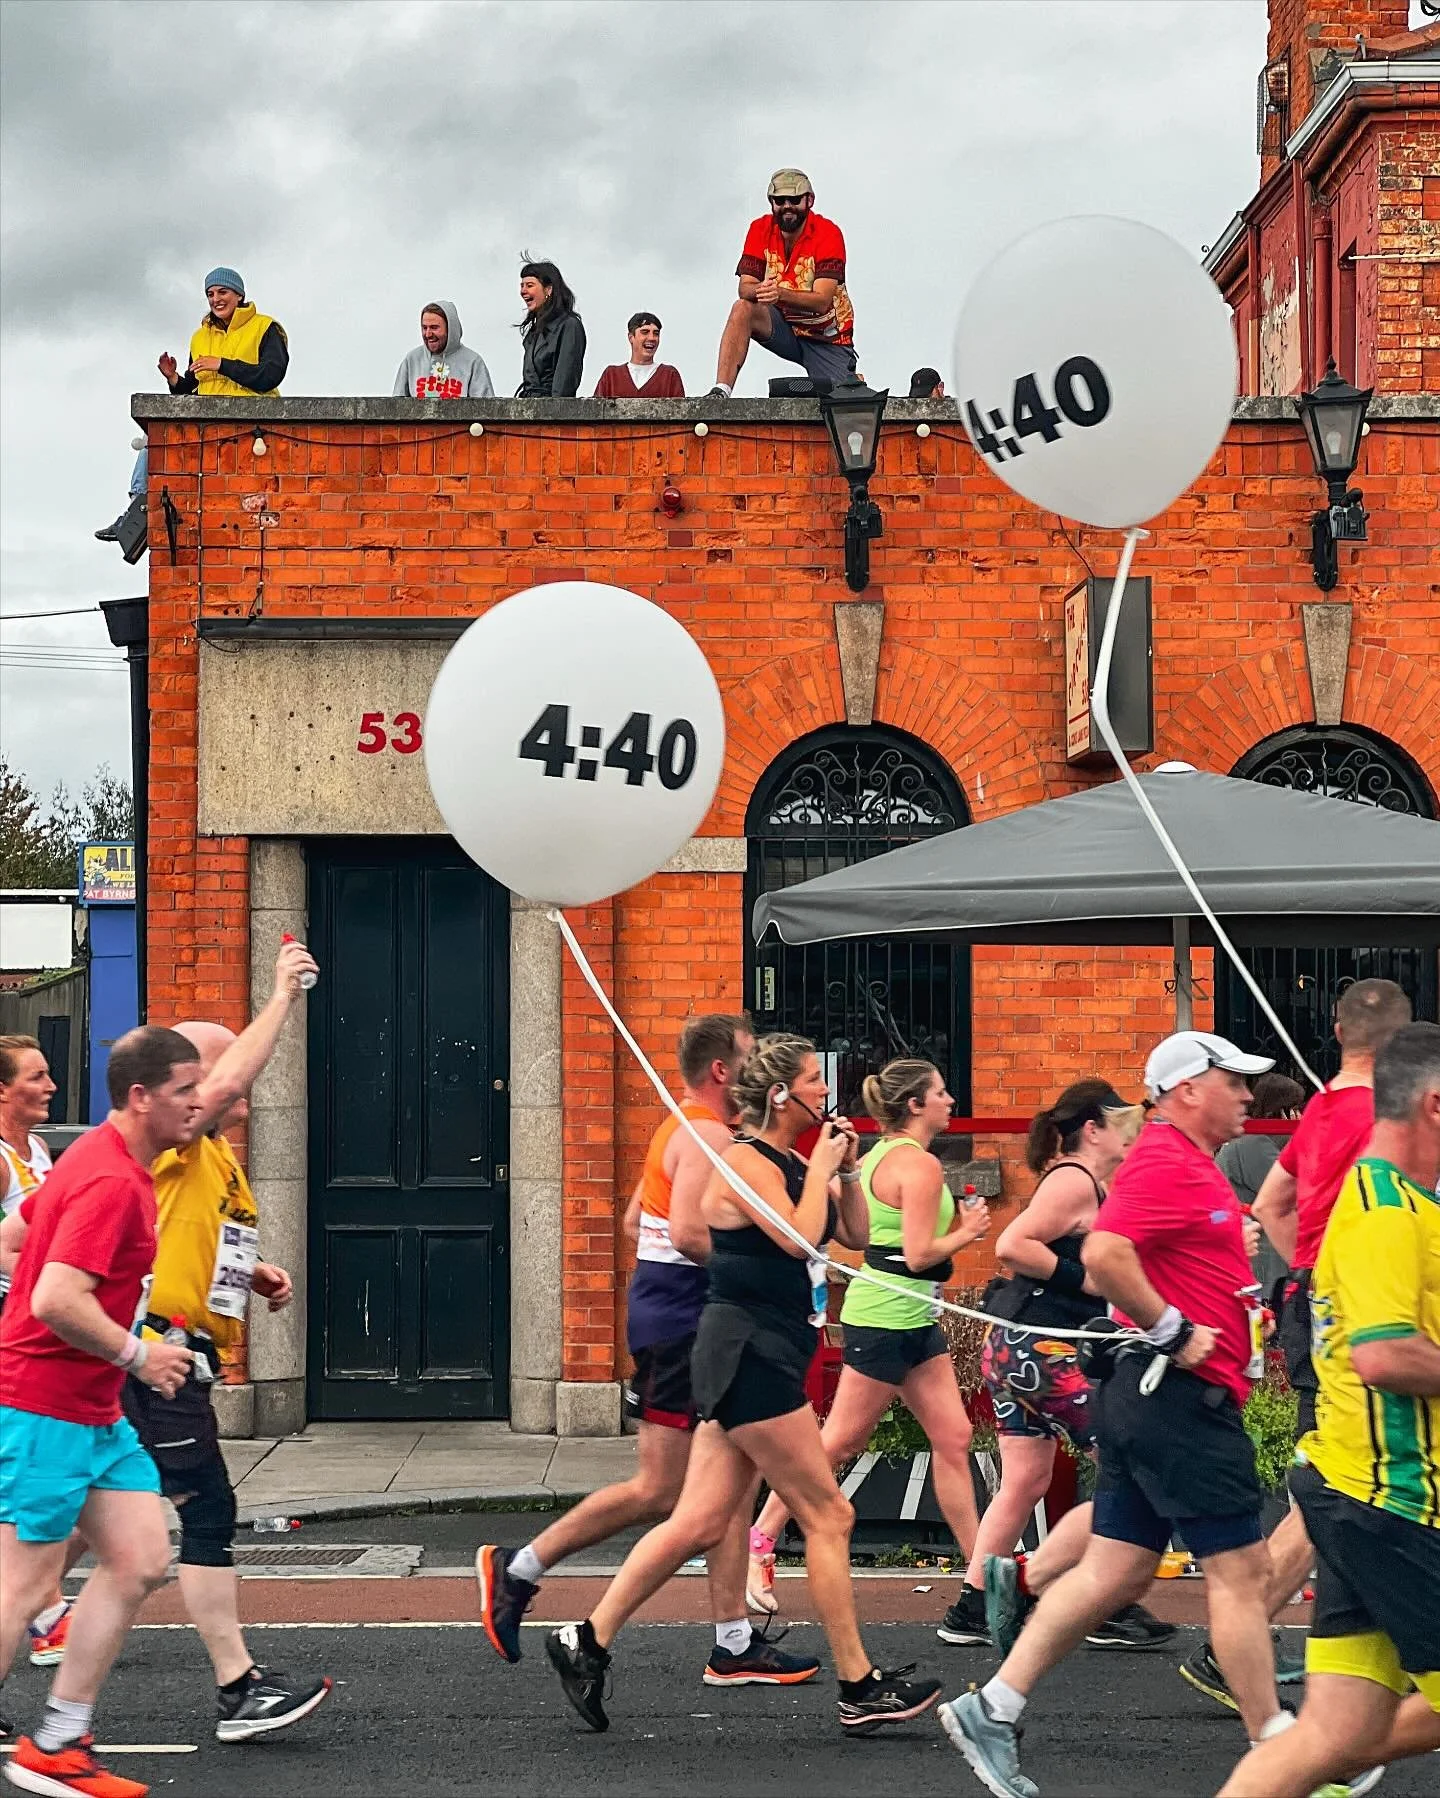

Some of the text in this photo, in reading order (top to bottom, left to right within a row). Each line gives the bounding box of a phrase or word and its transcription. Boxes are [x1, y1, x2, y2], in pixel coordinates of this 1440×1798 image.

[965, 355, 1111, 463] 4:40
[357, 702, 423, 754] 53
[518, 703, 698, 790] 4:40
